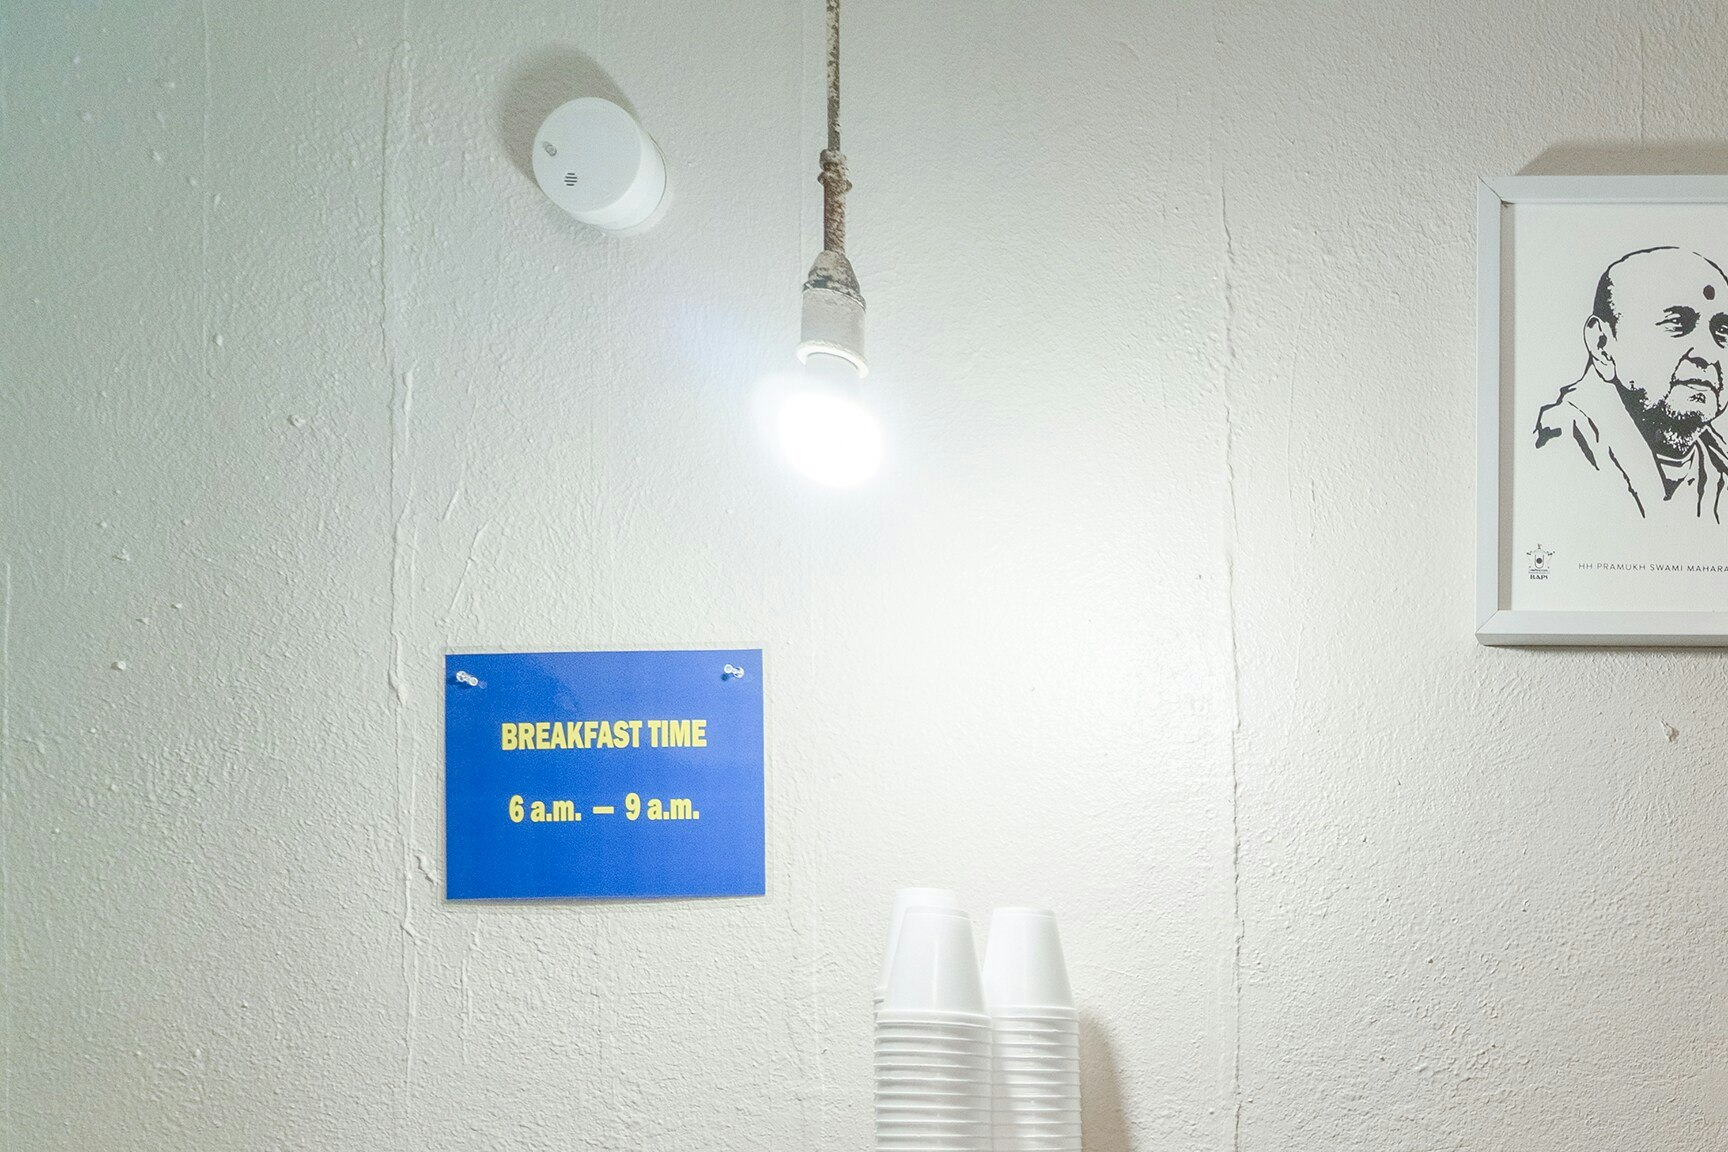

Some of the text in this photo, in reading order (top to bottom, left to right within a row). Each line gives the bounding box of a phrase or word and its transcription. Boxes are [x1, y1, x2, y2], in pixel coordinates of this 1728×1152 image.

[1578, 562, 1593, 570] HH
[1596, 562, 1646, 571] PRAMUKH
[1649, 563, 1683, 572] SWAMI
[501, 719, 708, 751] BREAKFAST TIME
[508, 794, 525, 823] 6
[530, 799, 582, 822] a.m.
[625, 792, 641, 821] 9
[647, 797, 700, 821] a.m.
